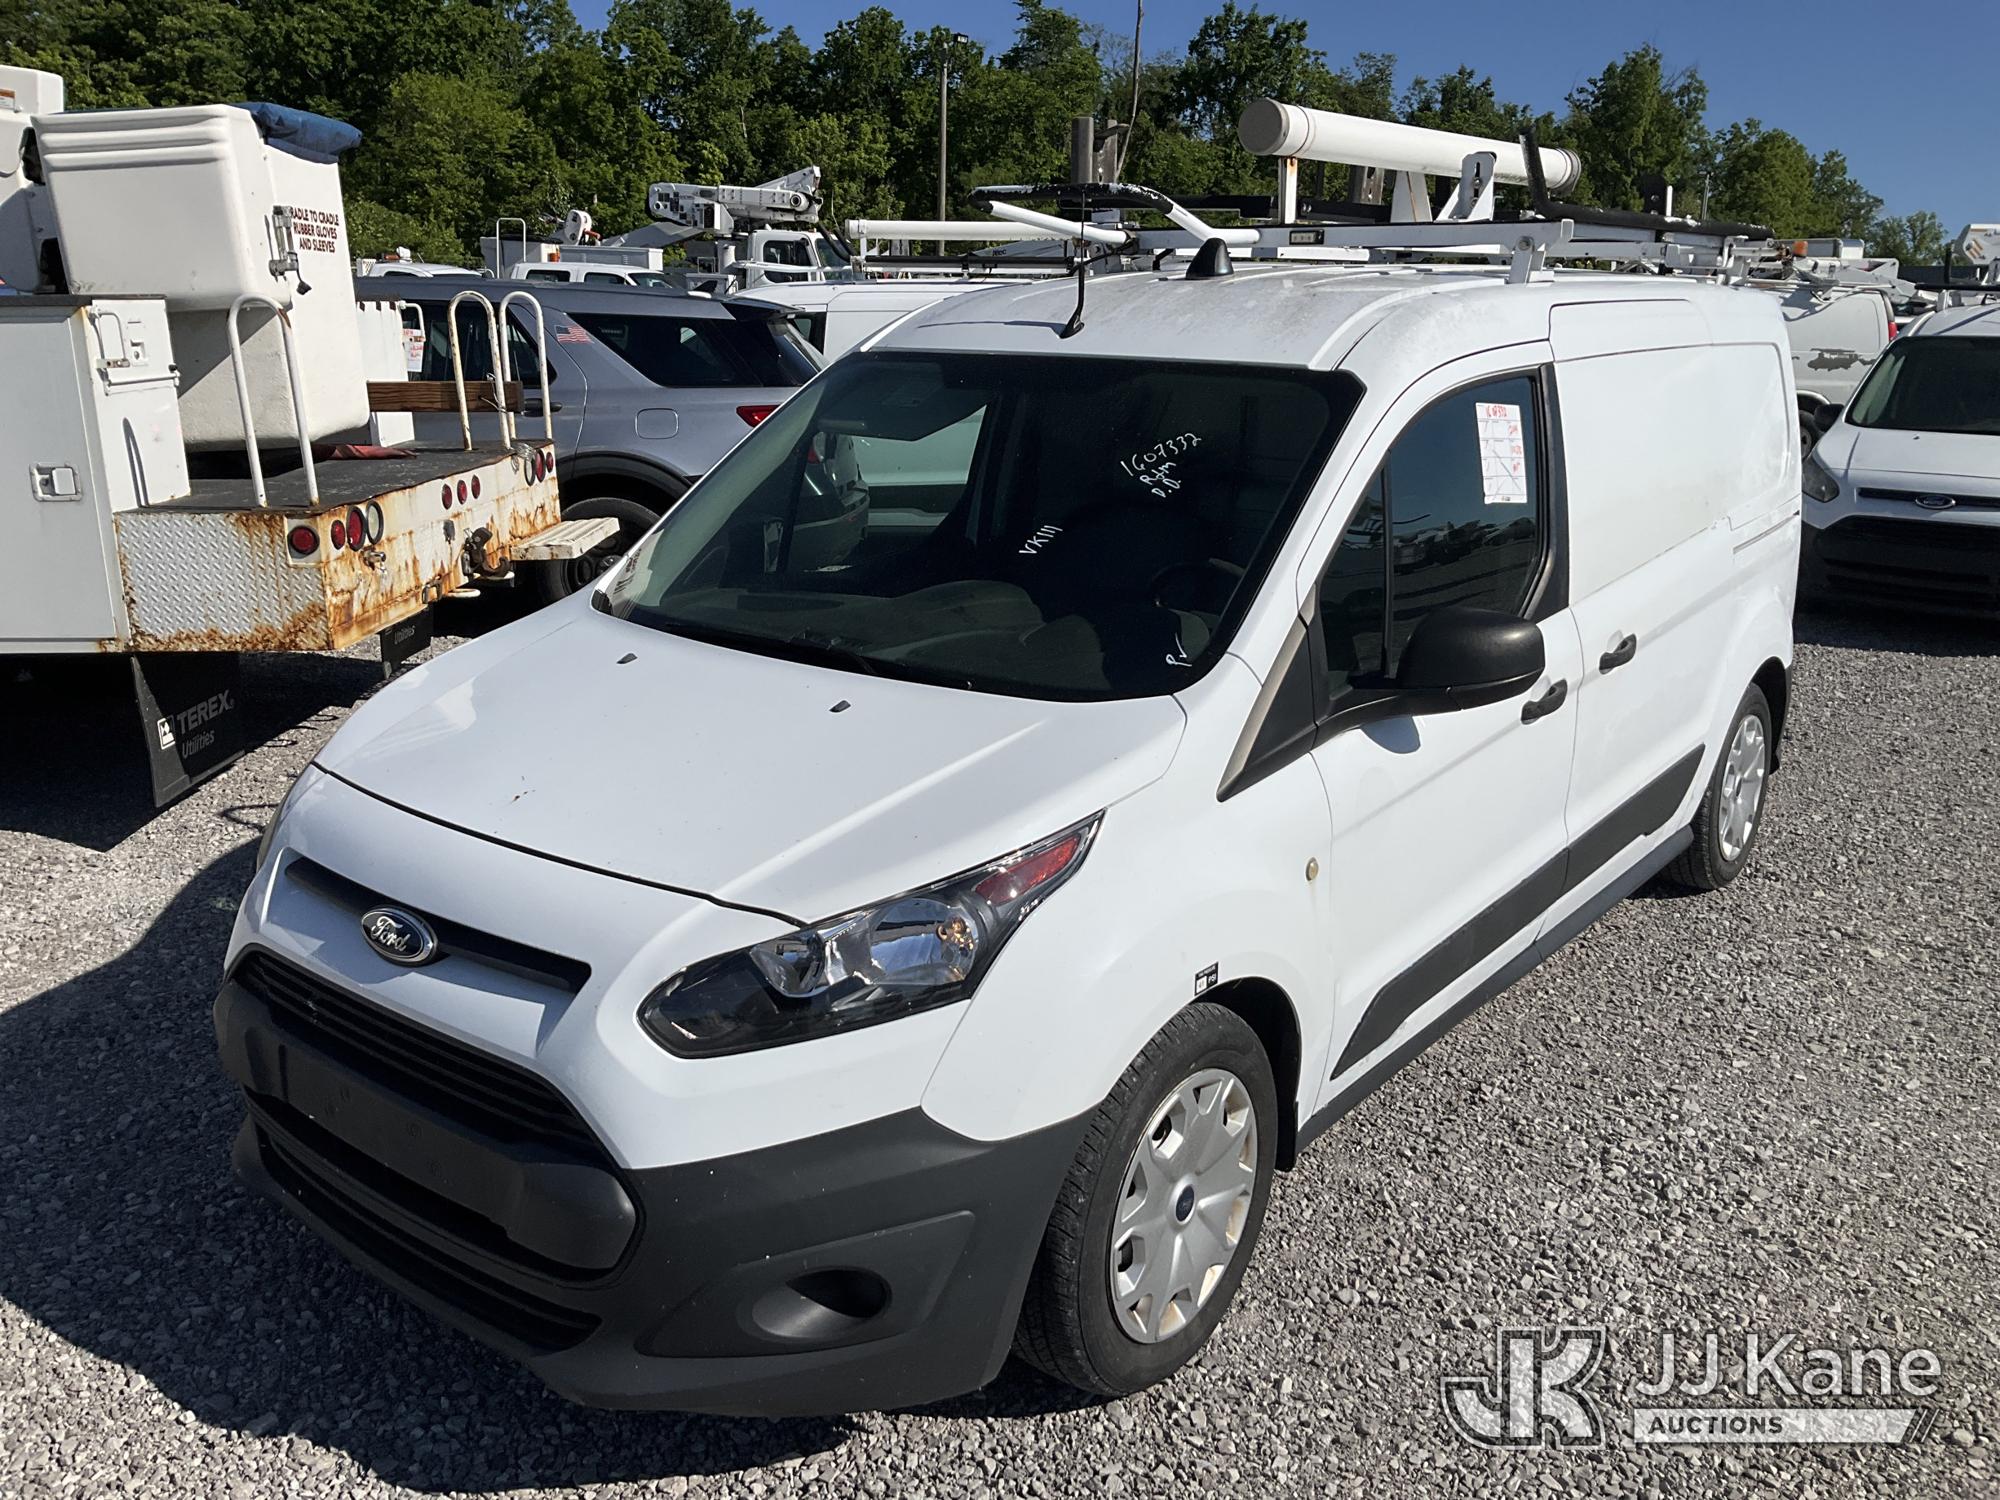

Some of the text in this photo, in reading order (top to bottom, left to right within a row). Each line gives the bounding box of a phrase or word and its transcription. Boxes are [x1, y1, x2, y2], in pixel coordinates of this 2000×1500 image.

[309, 209, 318, 223] TO
[318, 211, 339, 226] CRADLE
[293, 221, 337, 240] RUBBER GLOVES
[299, 237, 336, 253] AND SLEEVES
[176, 689, 231, 736] TEREX
[181, 729, 216, 760] Utilities
[370, 915, 412, 952] Ford
